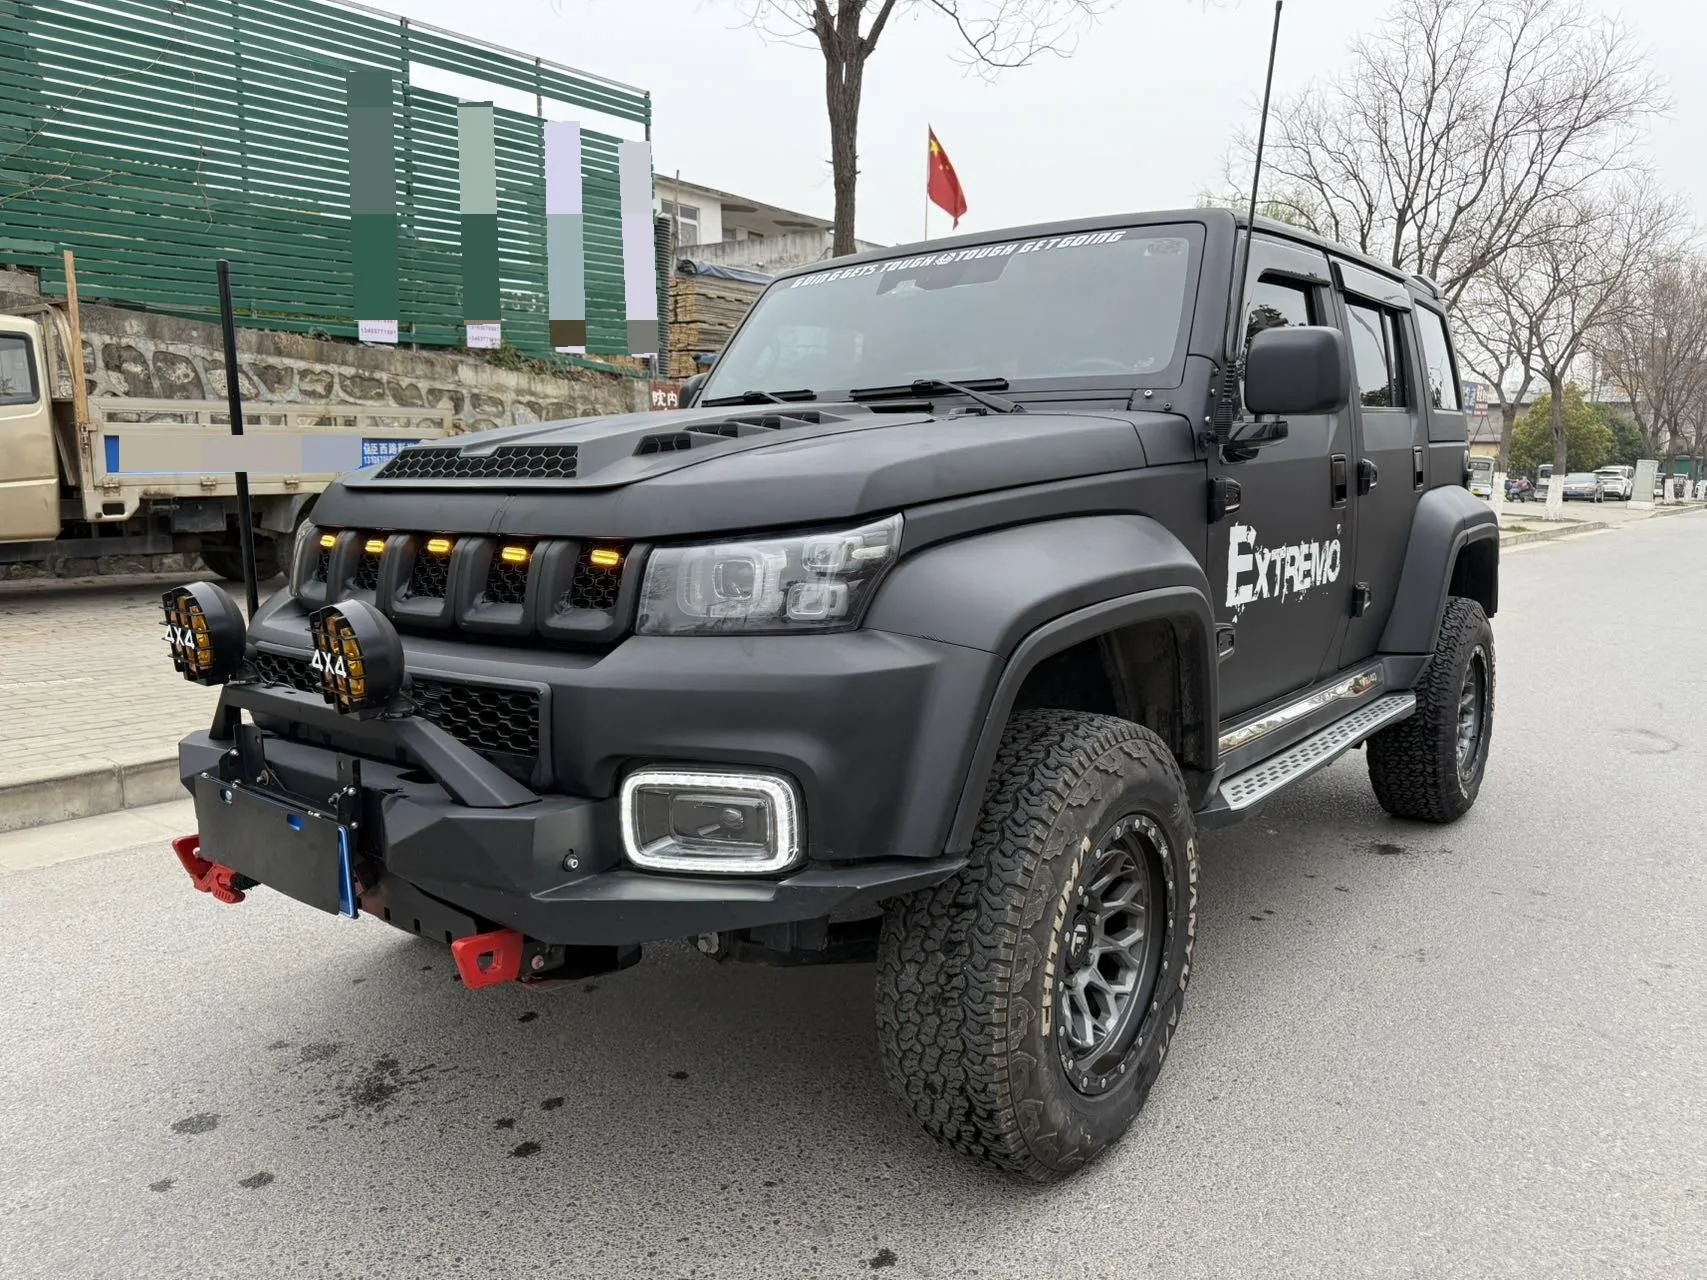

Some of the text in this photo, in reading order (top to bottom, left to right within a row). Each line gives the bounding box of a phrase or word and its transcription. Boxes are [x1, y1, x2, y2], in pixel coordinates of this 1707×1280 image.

[790, 231, 1127, 289] GOING GETS TOUGH TOUGH GET GOING
[164, 624, 195, 649] 4X4
[311, 649, 347, 679] 4X4
